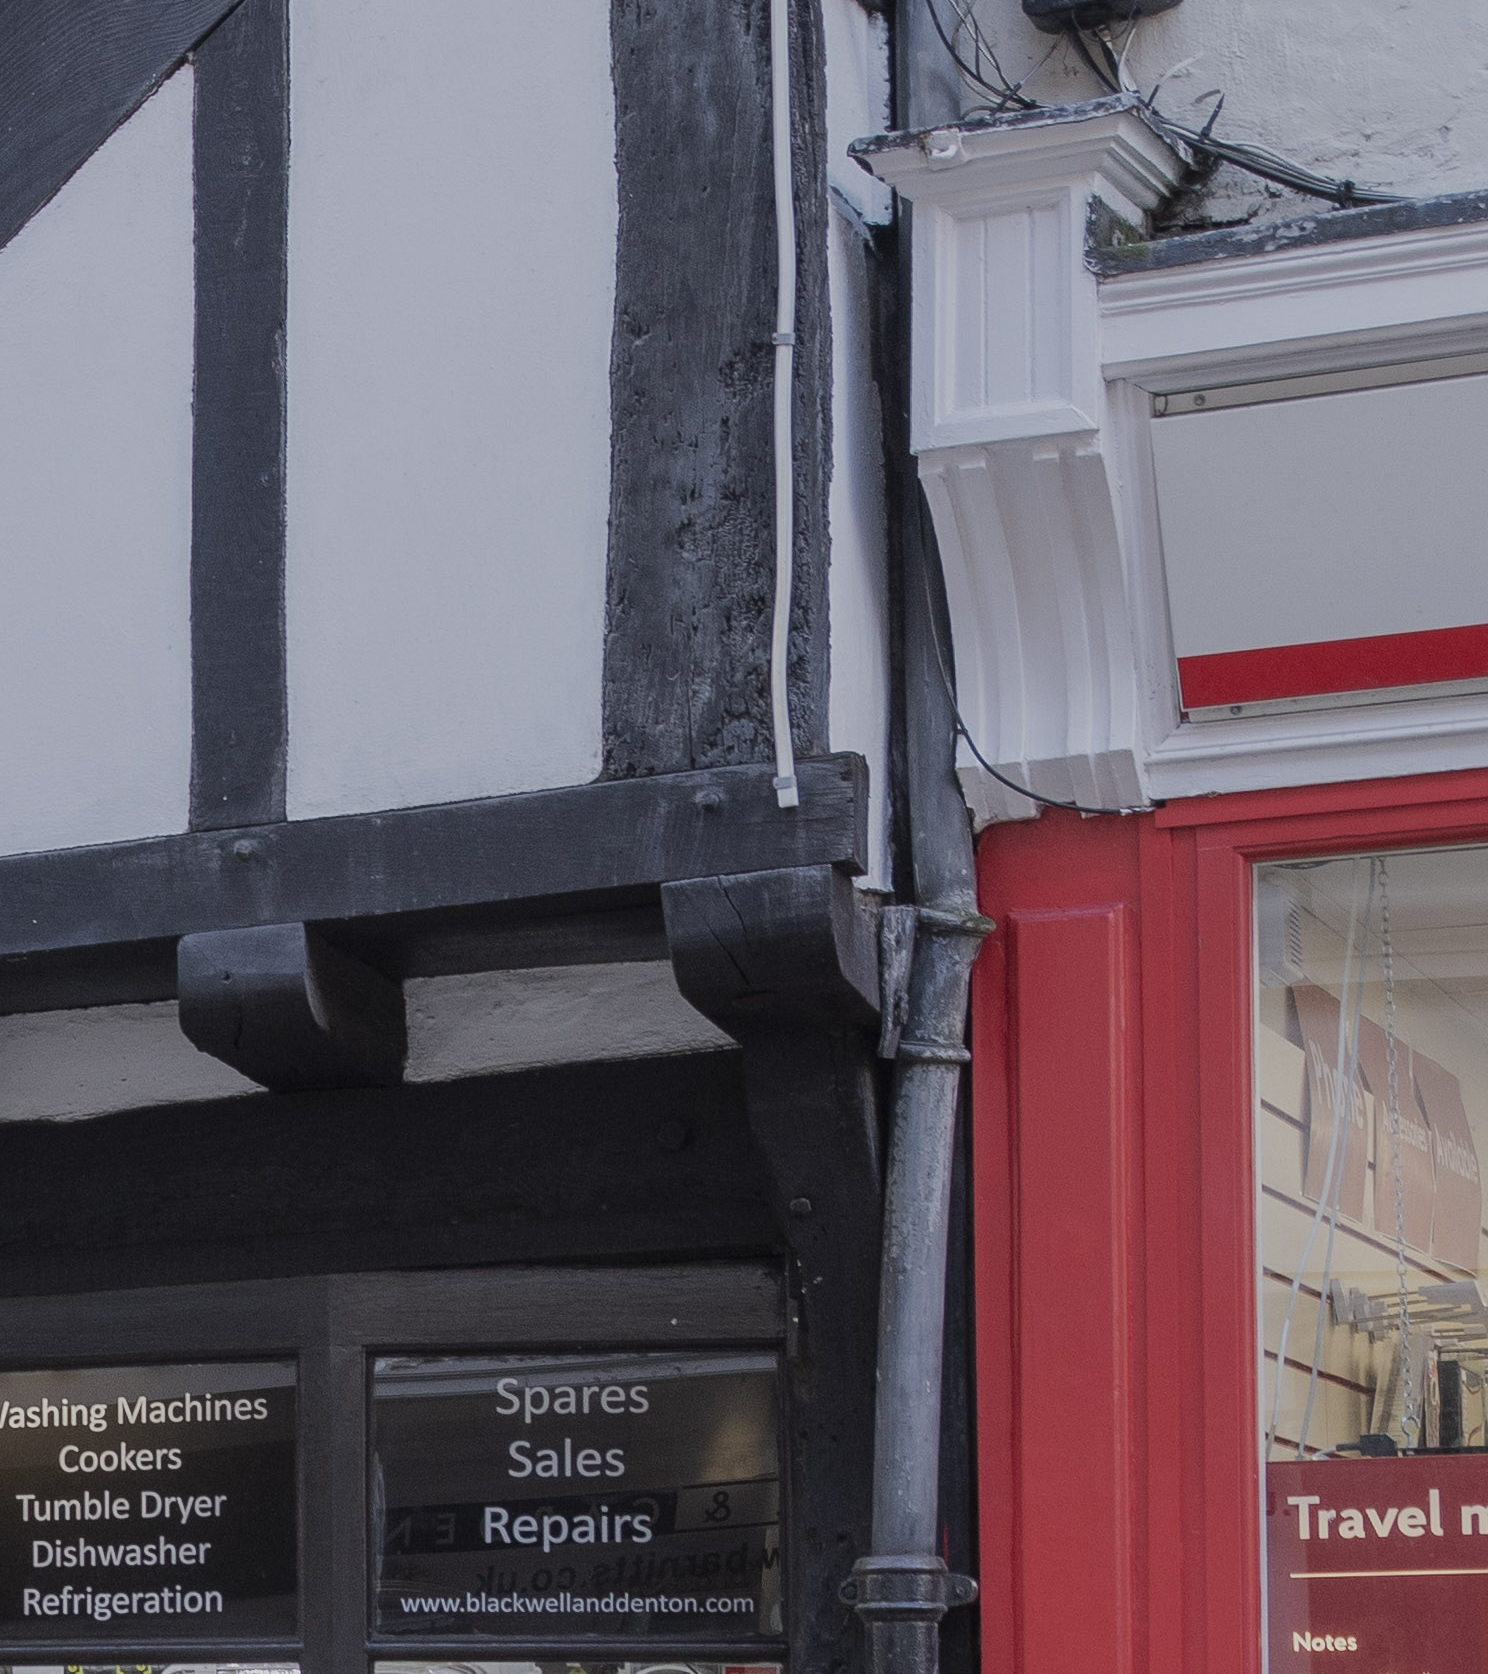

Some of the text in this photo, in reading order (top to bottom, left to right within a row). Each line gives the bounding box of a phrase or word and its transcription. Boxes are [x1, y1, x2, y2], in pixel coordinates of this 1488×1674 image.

[116, 1394, 269, 1425] Machines
[495, 1377, 649, 1424] Spares
[58, 1443, 183, 1473] Cookers
[508, 1438, 626, 1478] Sales
[16, 1491, 227, 1526] Tumble Dryer
[1287, 1489, 1444, 1540] Travel
[483, 1505, 654, 1553] Repairs
[32, 1538, 212, 1568] Dishwasher
[23, 1586, 224, 1621] Refrigeration
[400, 1592, 755, 1614] www.blackwellanddenton.com
[1293, 1632, 1358, 1653] Notes
